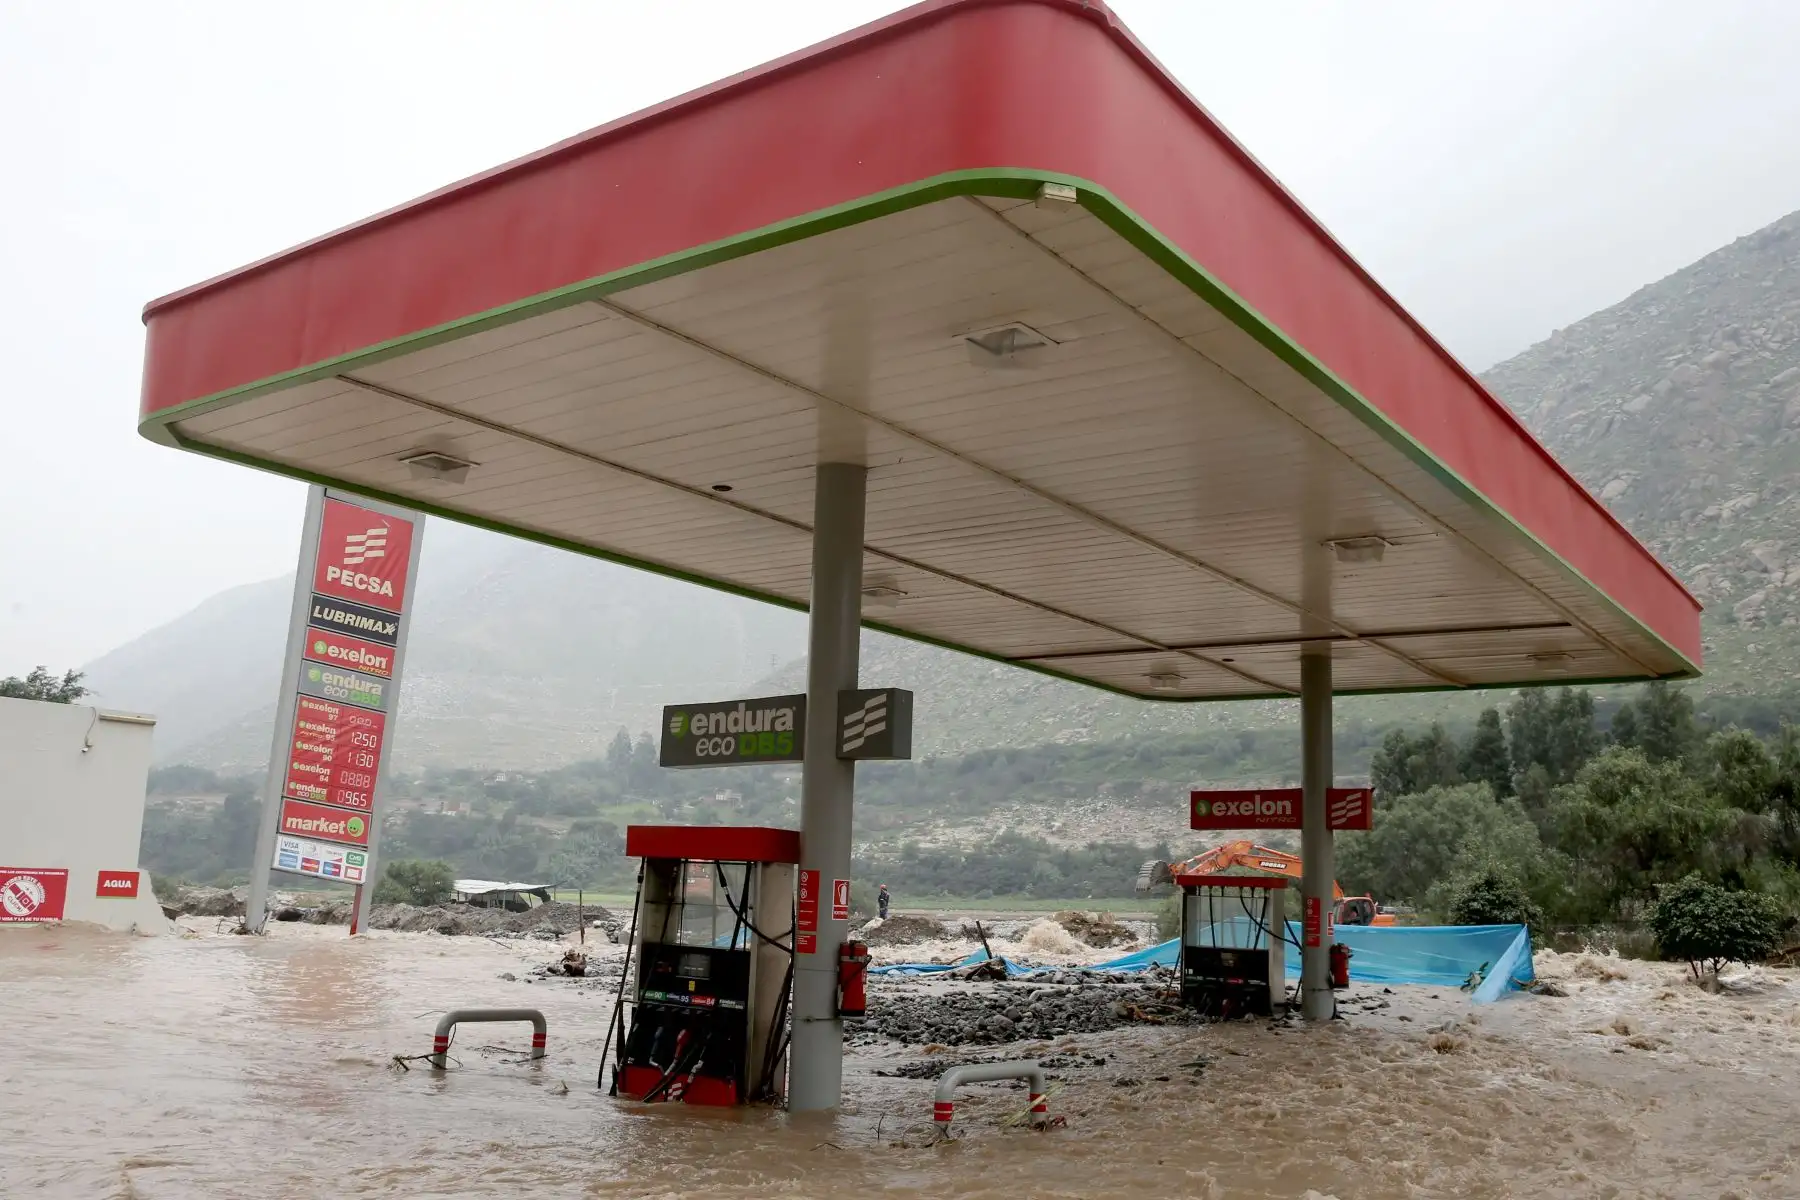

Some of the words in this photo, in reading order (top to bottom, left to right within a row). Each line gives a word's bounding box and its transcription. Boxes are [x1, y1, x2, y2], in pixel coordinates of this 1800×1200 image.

[326, 565, 393, 597] PECSA
[312, 605, 397, 636] LUBRIMAX
[327, 644, 388, 669] exelon
[358, 664, 389, 677] NITRO
[322, 672, 383, 696] endura
[324, 685, 349, 698] eco
[308, 702, 340, 716] exelon
[690, 702, 795, 736] endura
[305, 723, 337, 735] exelon
[302, 743, 333, 755] exelon
[695, 735, 736, 757] eco
[299, 764, 331, 776] exelon
[295, 782, 328, 795] endura
[1212, 794, 1293, 817] exelon
[285, 817, 346, 835] market
[283, 840, 299, 849] VISA
[654, 991, 663, 999] 90
[680, 995, 689, 1003] 95
